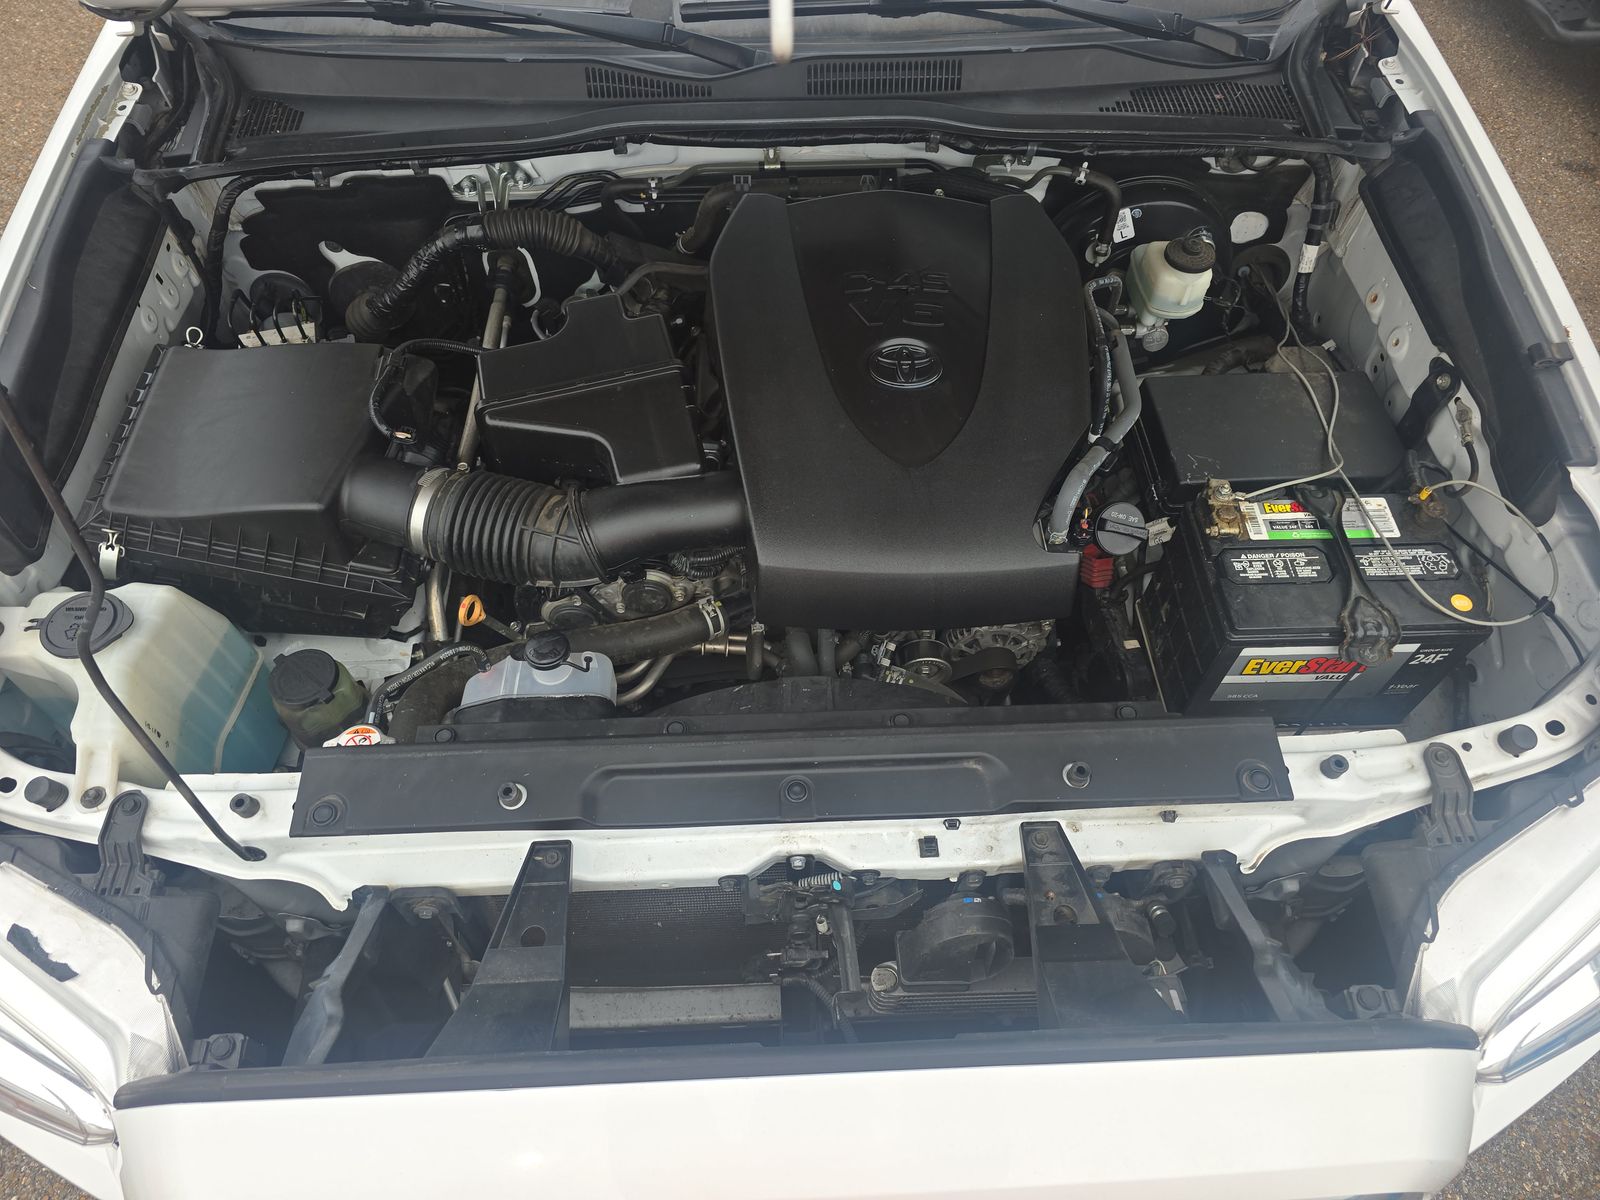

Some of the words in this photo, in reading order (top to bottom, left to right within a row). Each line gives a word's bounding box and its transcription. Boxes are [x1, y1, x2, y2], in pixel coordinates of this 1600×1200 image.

[846, 299, 946, 327] V6
[1128, 515, 1139, 523] SAE
[1408, 653, 1449, 665] 24F
